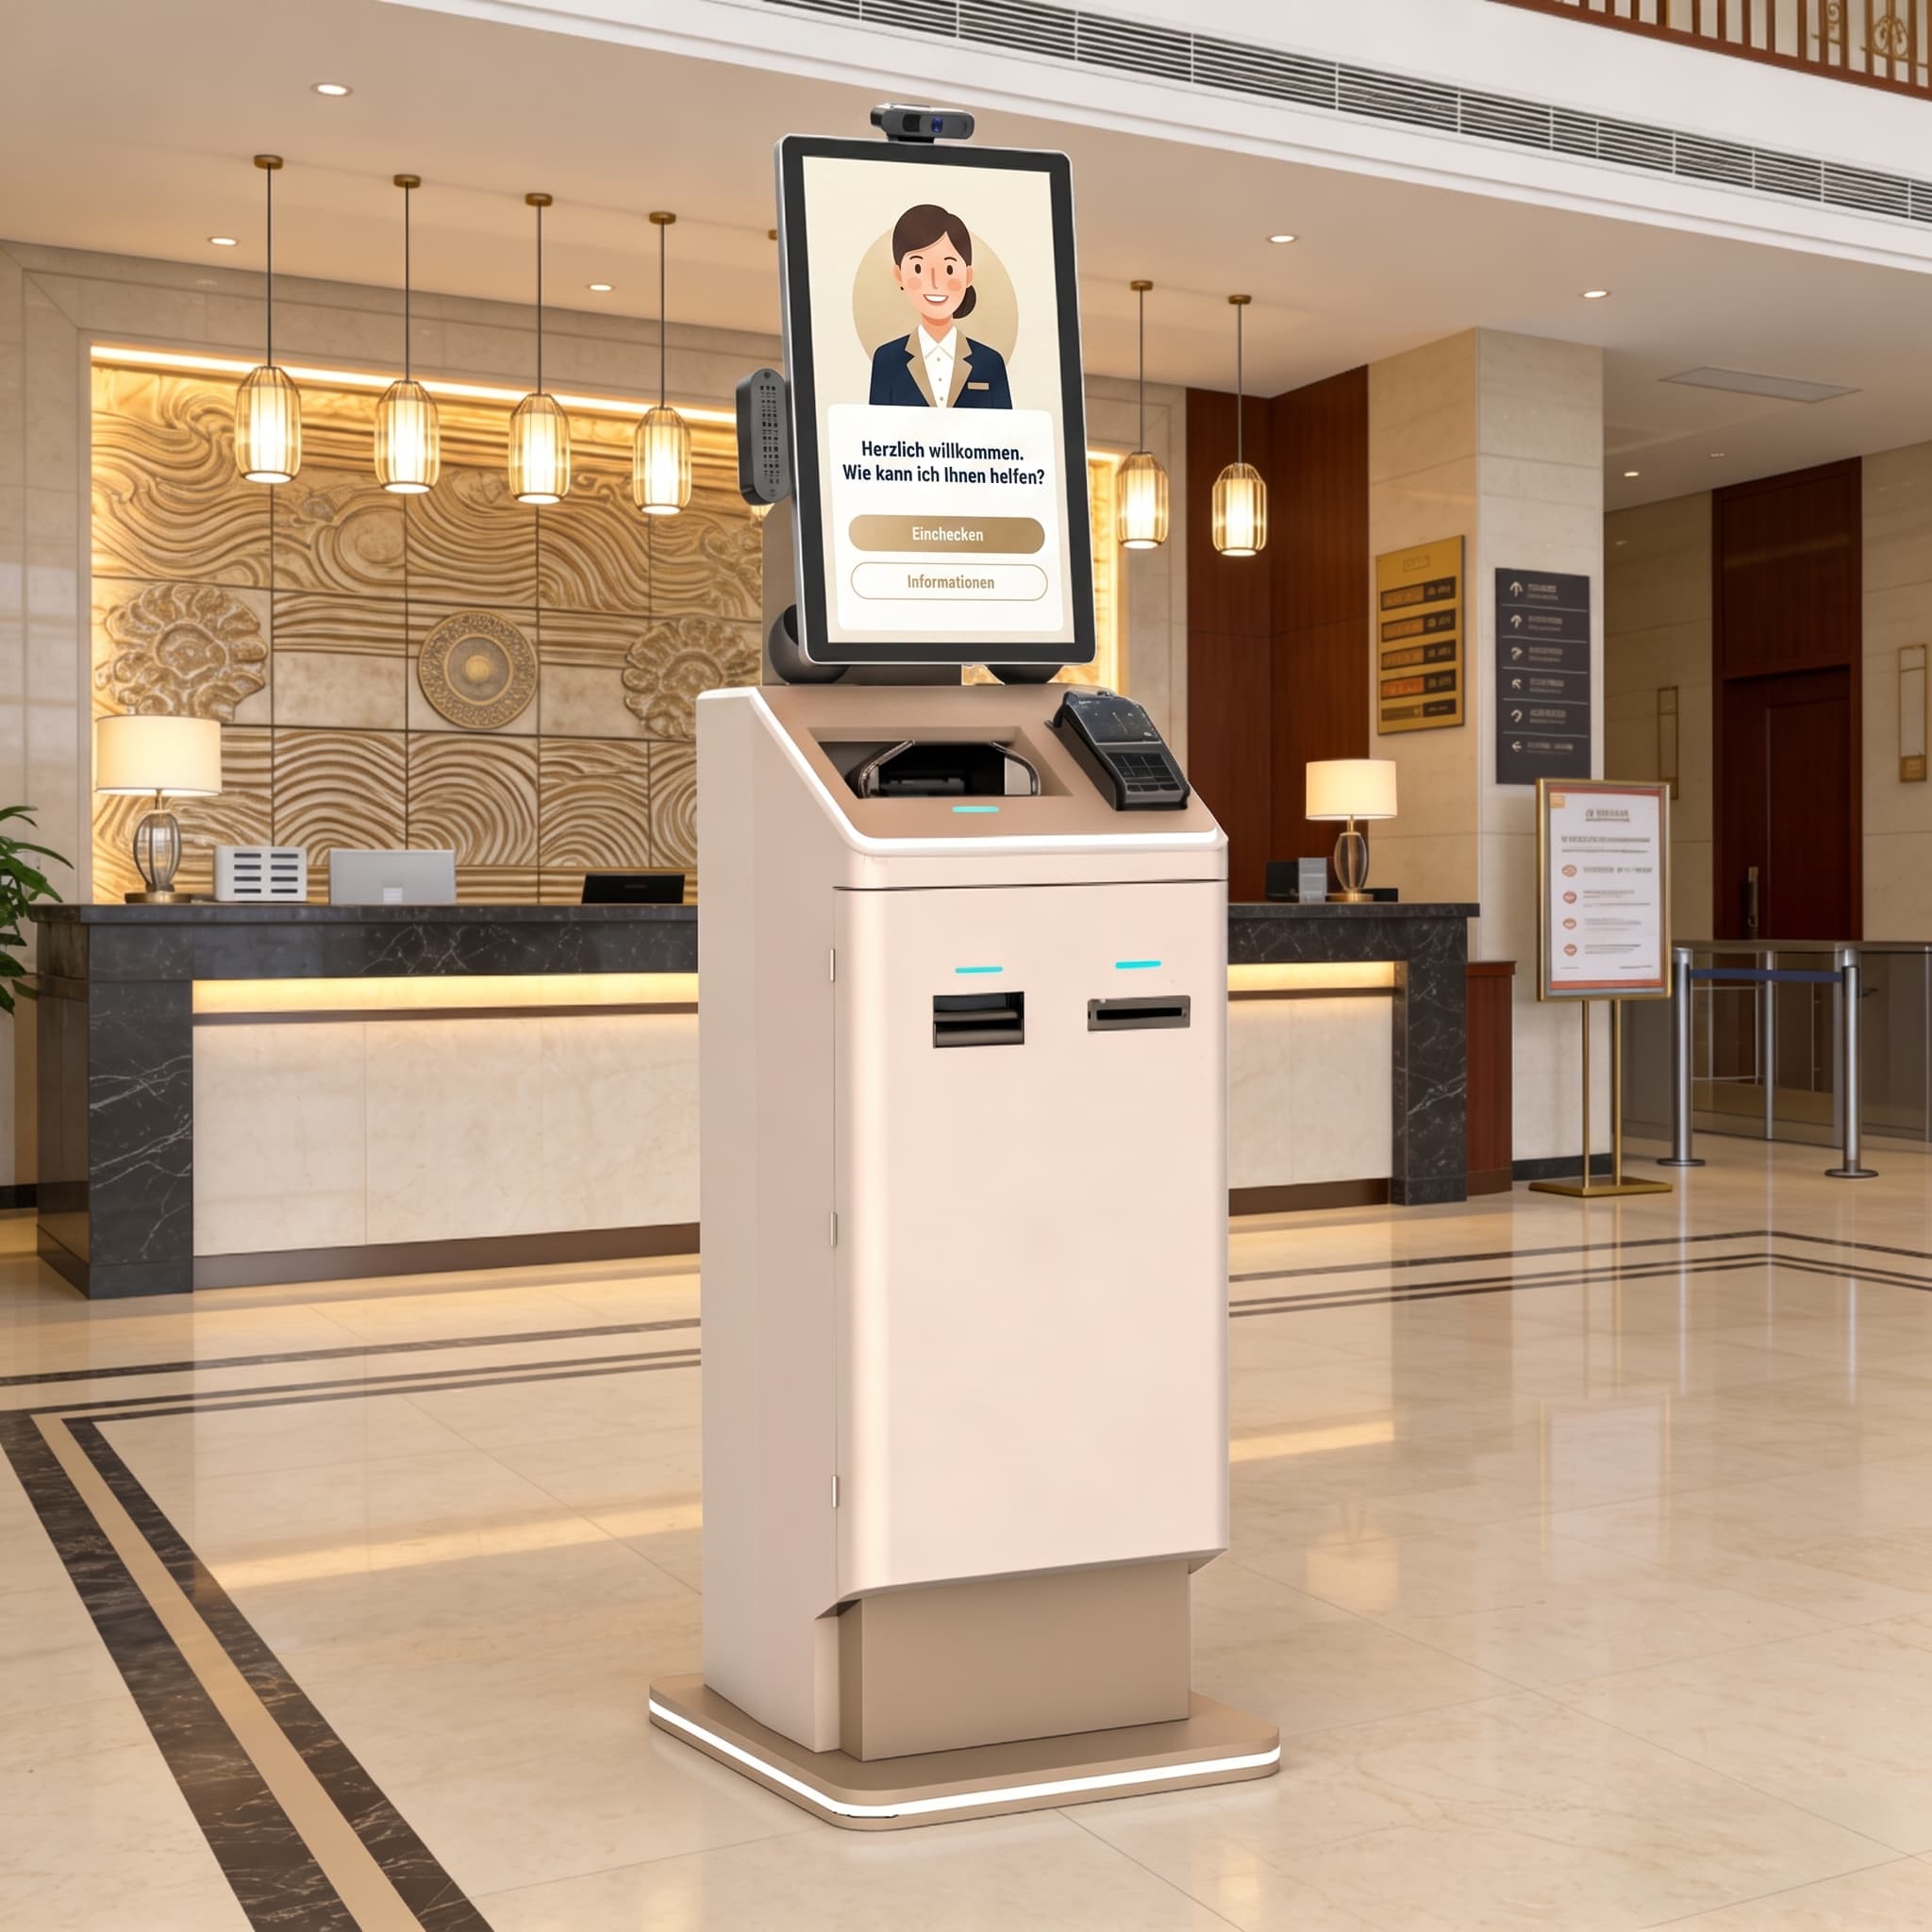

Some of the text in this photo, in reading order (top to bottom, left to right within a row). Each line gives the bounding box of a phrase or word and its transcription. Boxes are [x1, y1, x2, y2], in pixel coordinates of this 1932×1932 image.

[861, 441, 1024, 460] Herzlich willkommen.
[842, 464, 1045, 485] Wie kann ich Ihnen helfen?
[912, 525, 984, 541] Einchecken
[907, 574, 995, 590] Informationen
